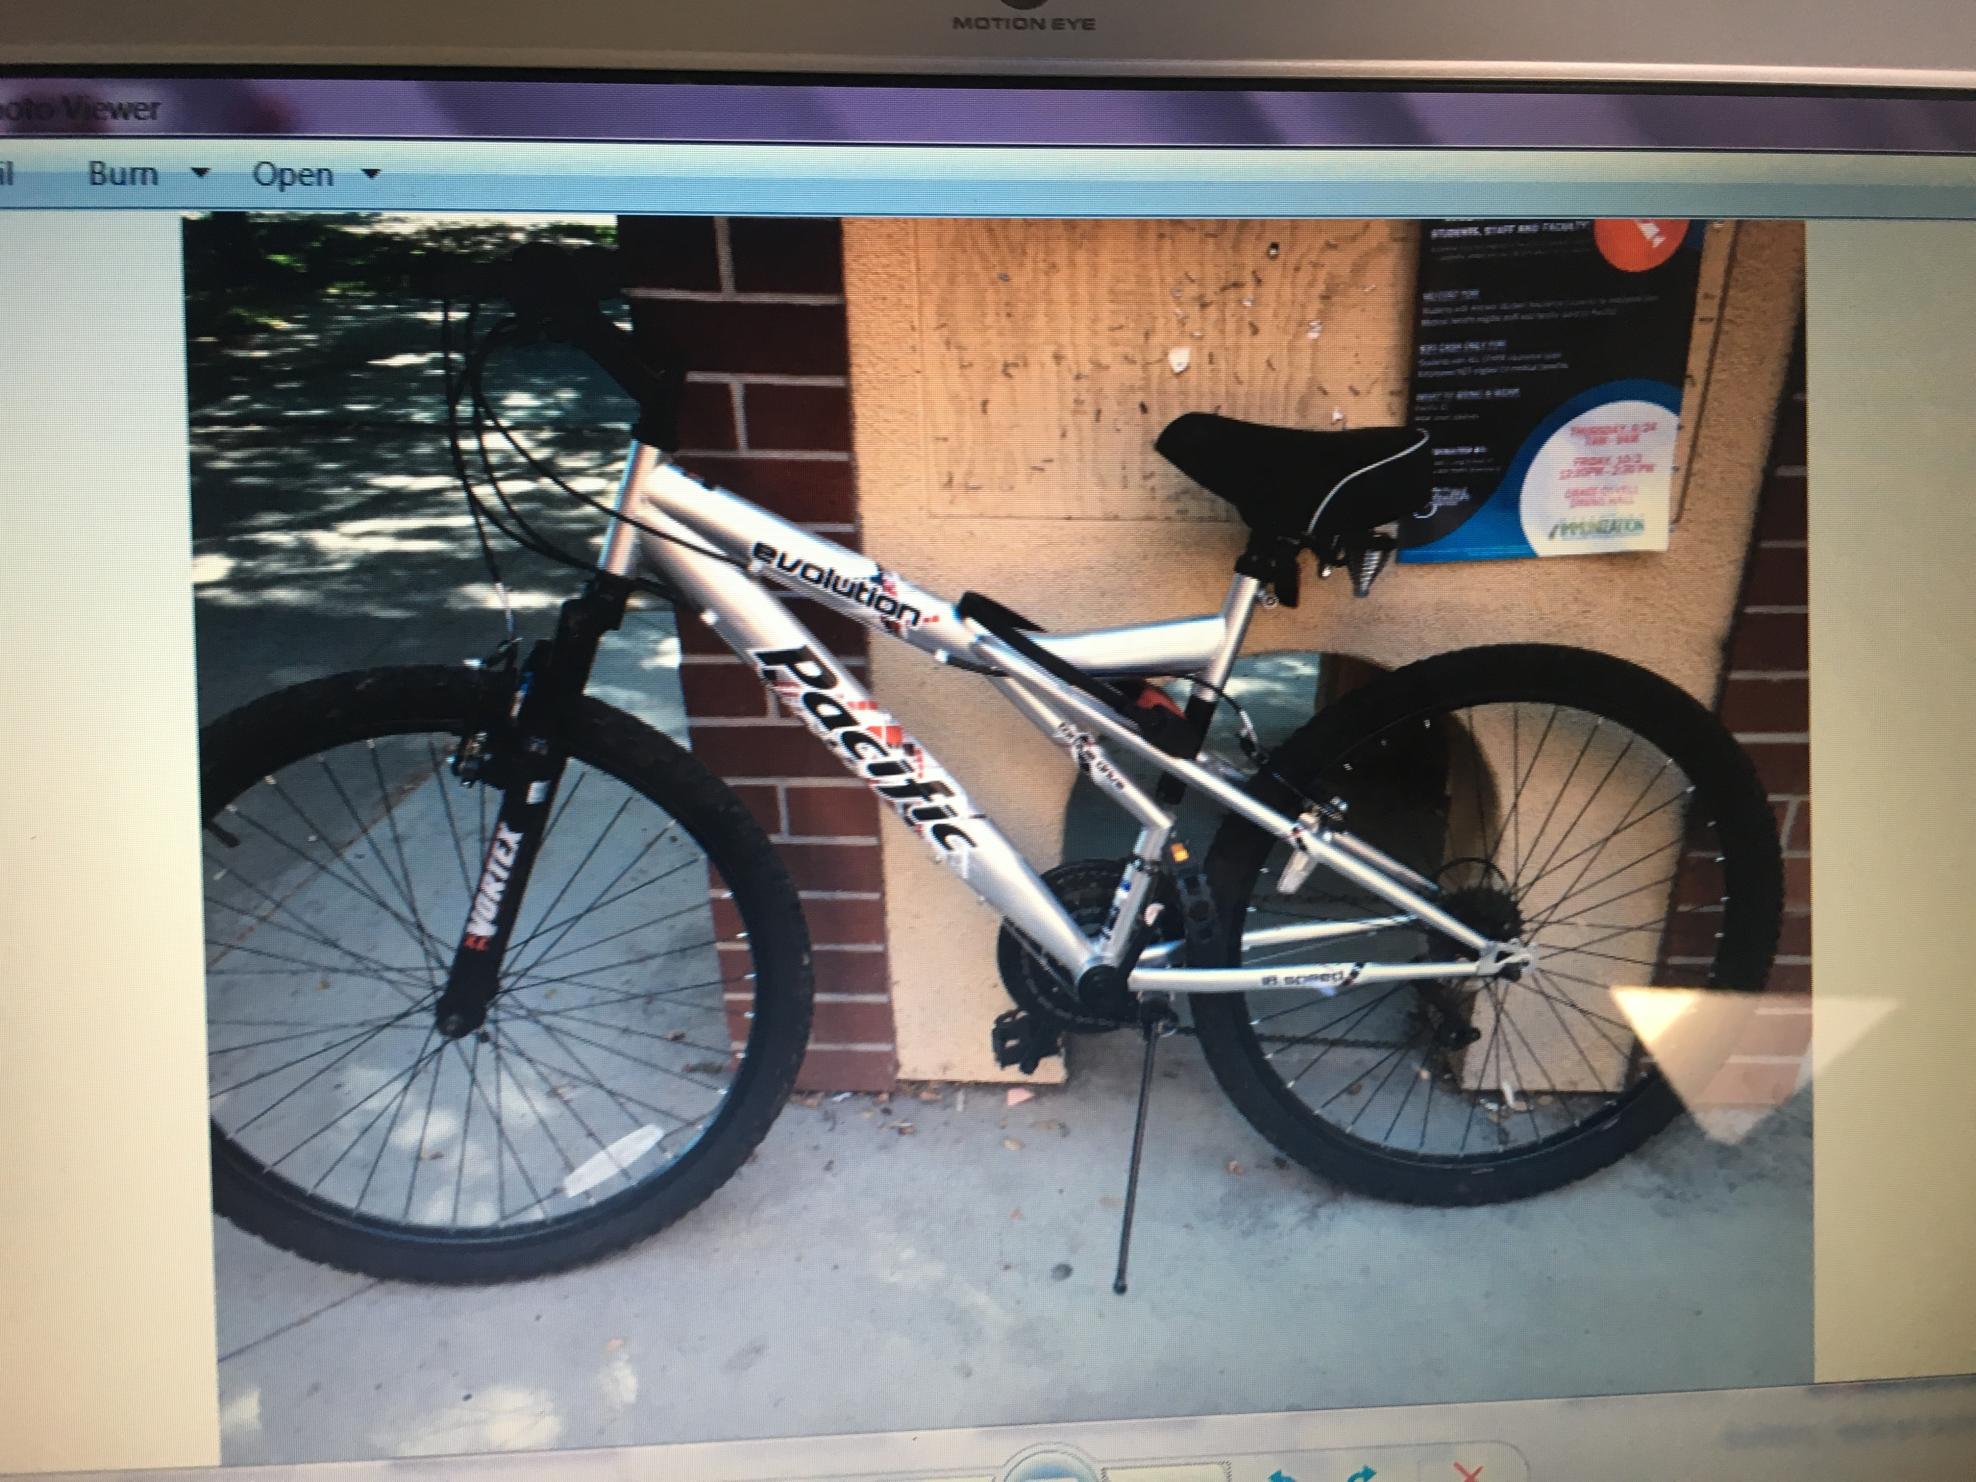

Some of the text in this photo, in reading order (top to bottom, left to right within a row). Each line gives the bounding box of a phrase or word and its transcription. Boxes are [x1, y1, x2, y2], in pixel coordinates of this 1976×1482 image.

[952, 17, 1097, 31] MOTION EYE
[0, 96, 161, 121] oto Viewer
[89, 160, 160, 187] Burn
[253, 160, 335, 192] Open
[752, 541, 921, 627] evolution
[753, 645, 977, 852] Pacific
[466, 824, 525, 937] VORTEX
